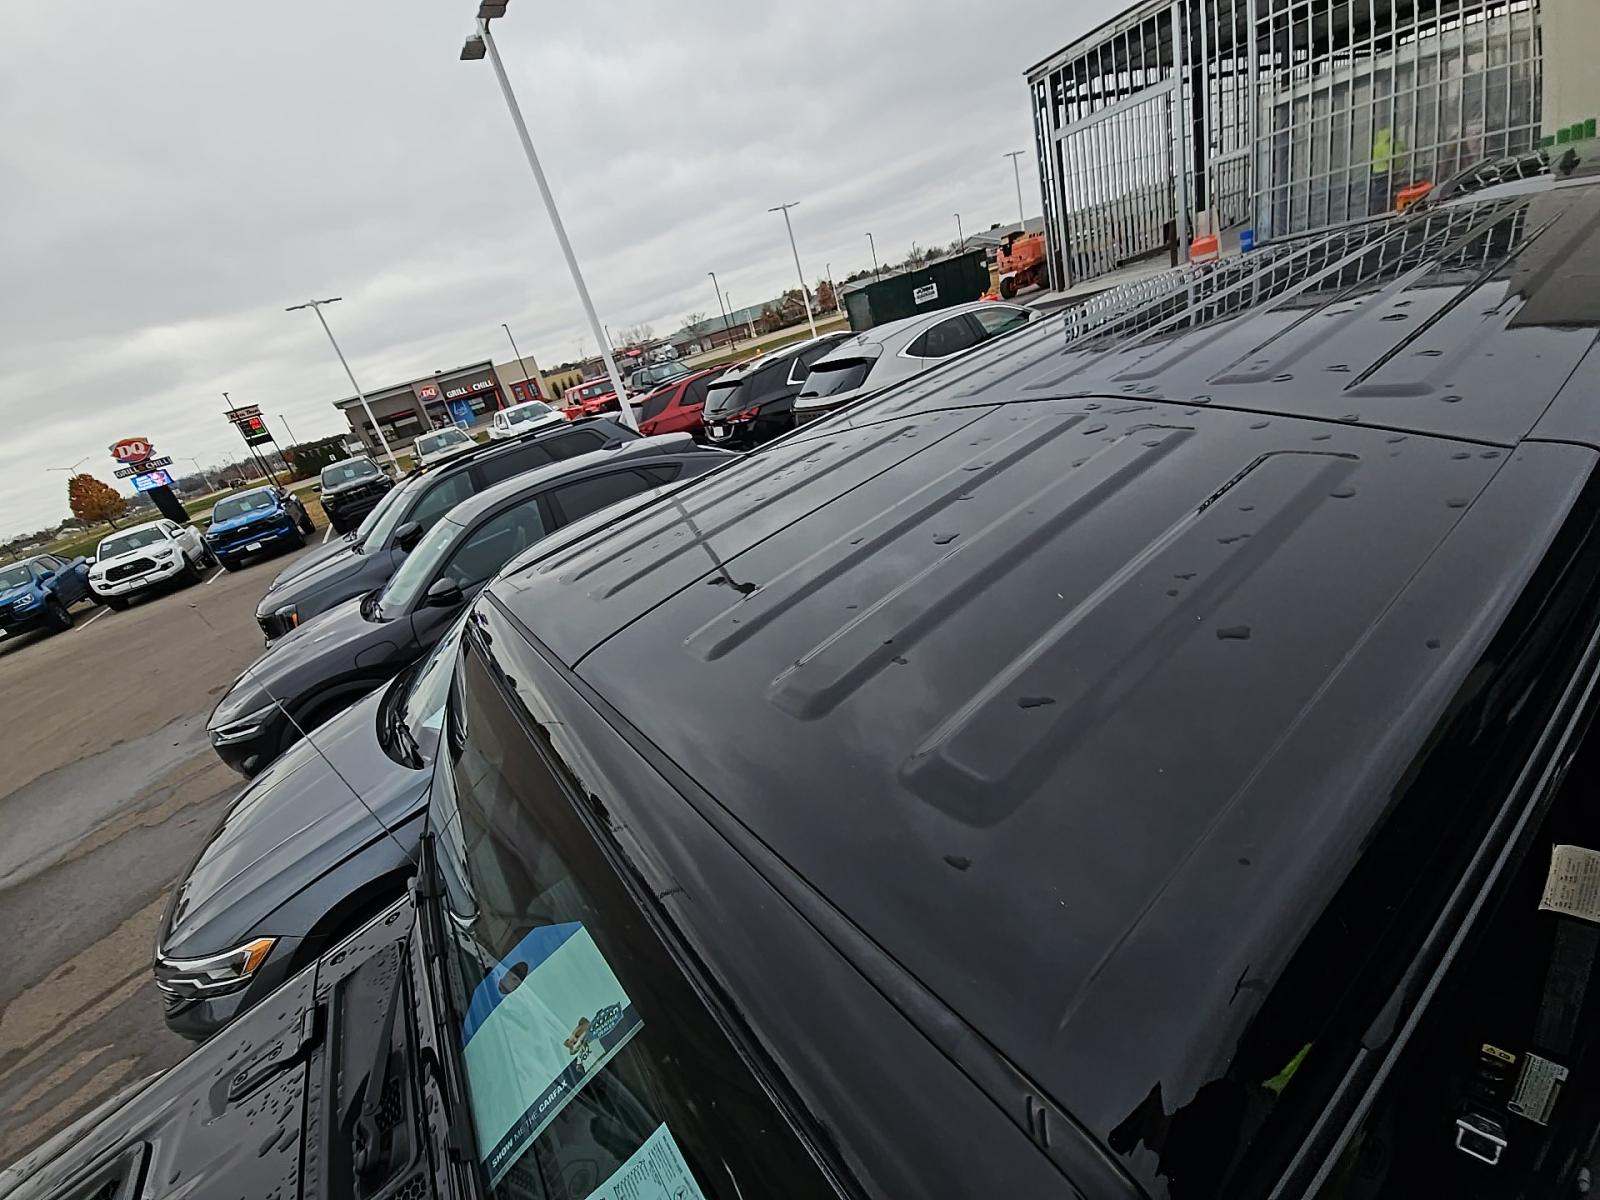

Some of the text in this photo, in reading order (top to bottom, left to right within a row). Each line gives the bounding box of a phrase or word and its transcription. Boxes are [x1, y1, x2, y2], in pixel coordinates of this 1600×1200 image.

[422, 388, 437, 397] DQ
[446, 387, 468, 398] GRILL
[472, 379, 494, 391] CHILL
[116, 441, 147, 458] DQ
[115, 466, 140, 478] GRILL
[145, 459, 169, 470] CHILL
[491, 1079, 568, 1168] SHOW ME THE CARFAX
